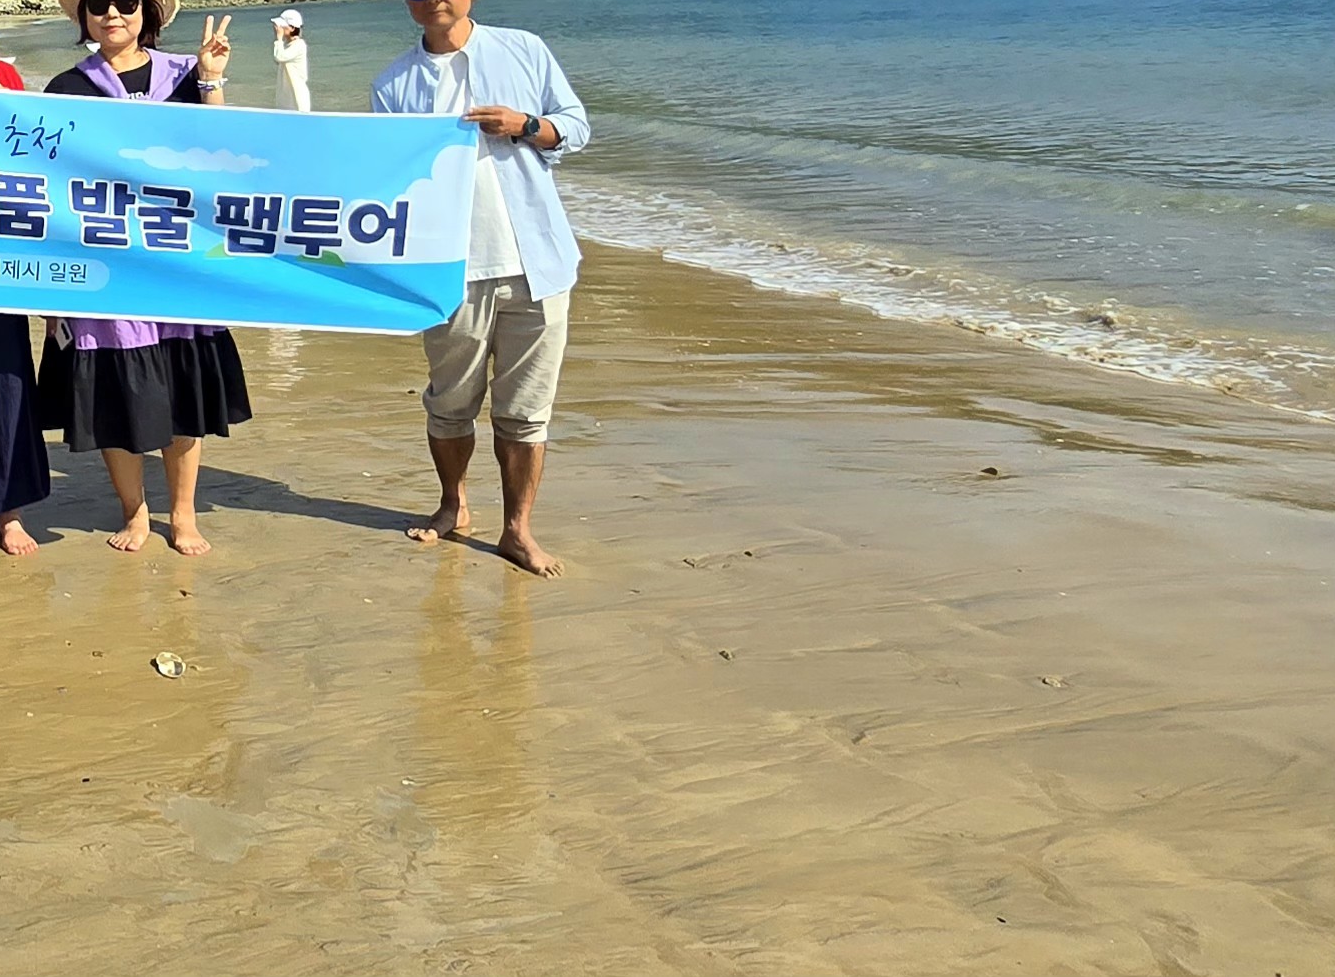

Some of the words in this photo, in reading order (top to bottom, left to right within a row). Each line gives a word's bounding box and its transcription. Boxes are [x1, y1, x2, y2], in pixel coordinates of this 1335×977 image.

[69, 178, 199, 253] 발굴
[213, 192, 411, 259] 팸투어
[48, 262, 88, 284] 일원
